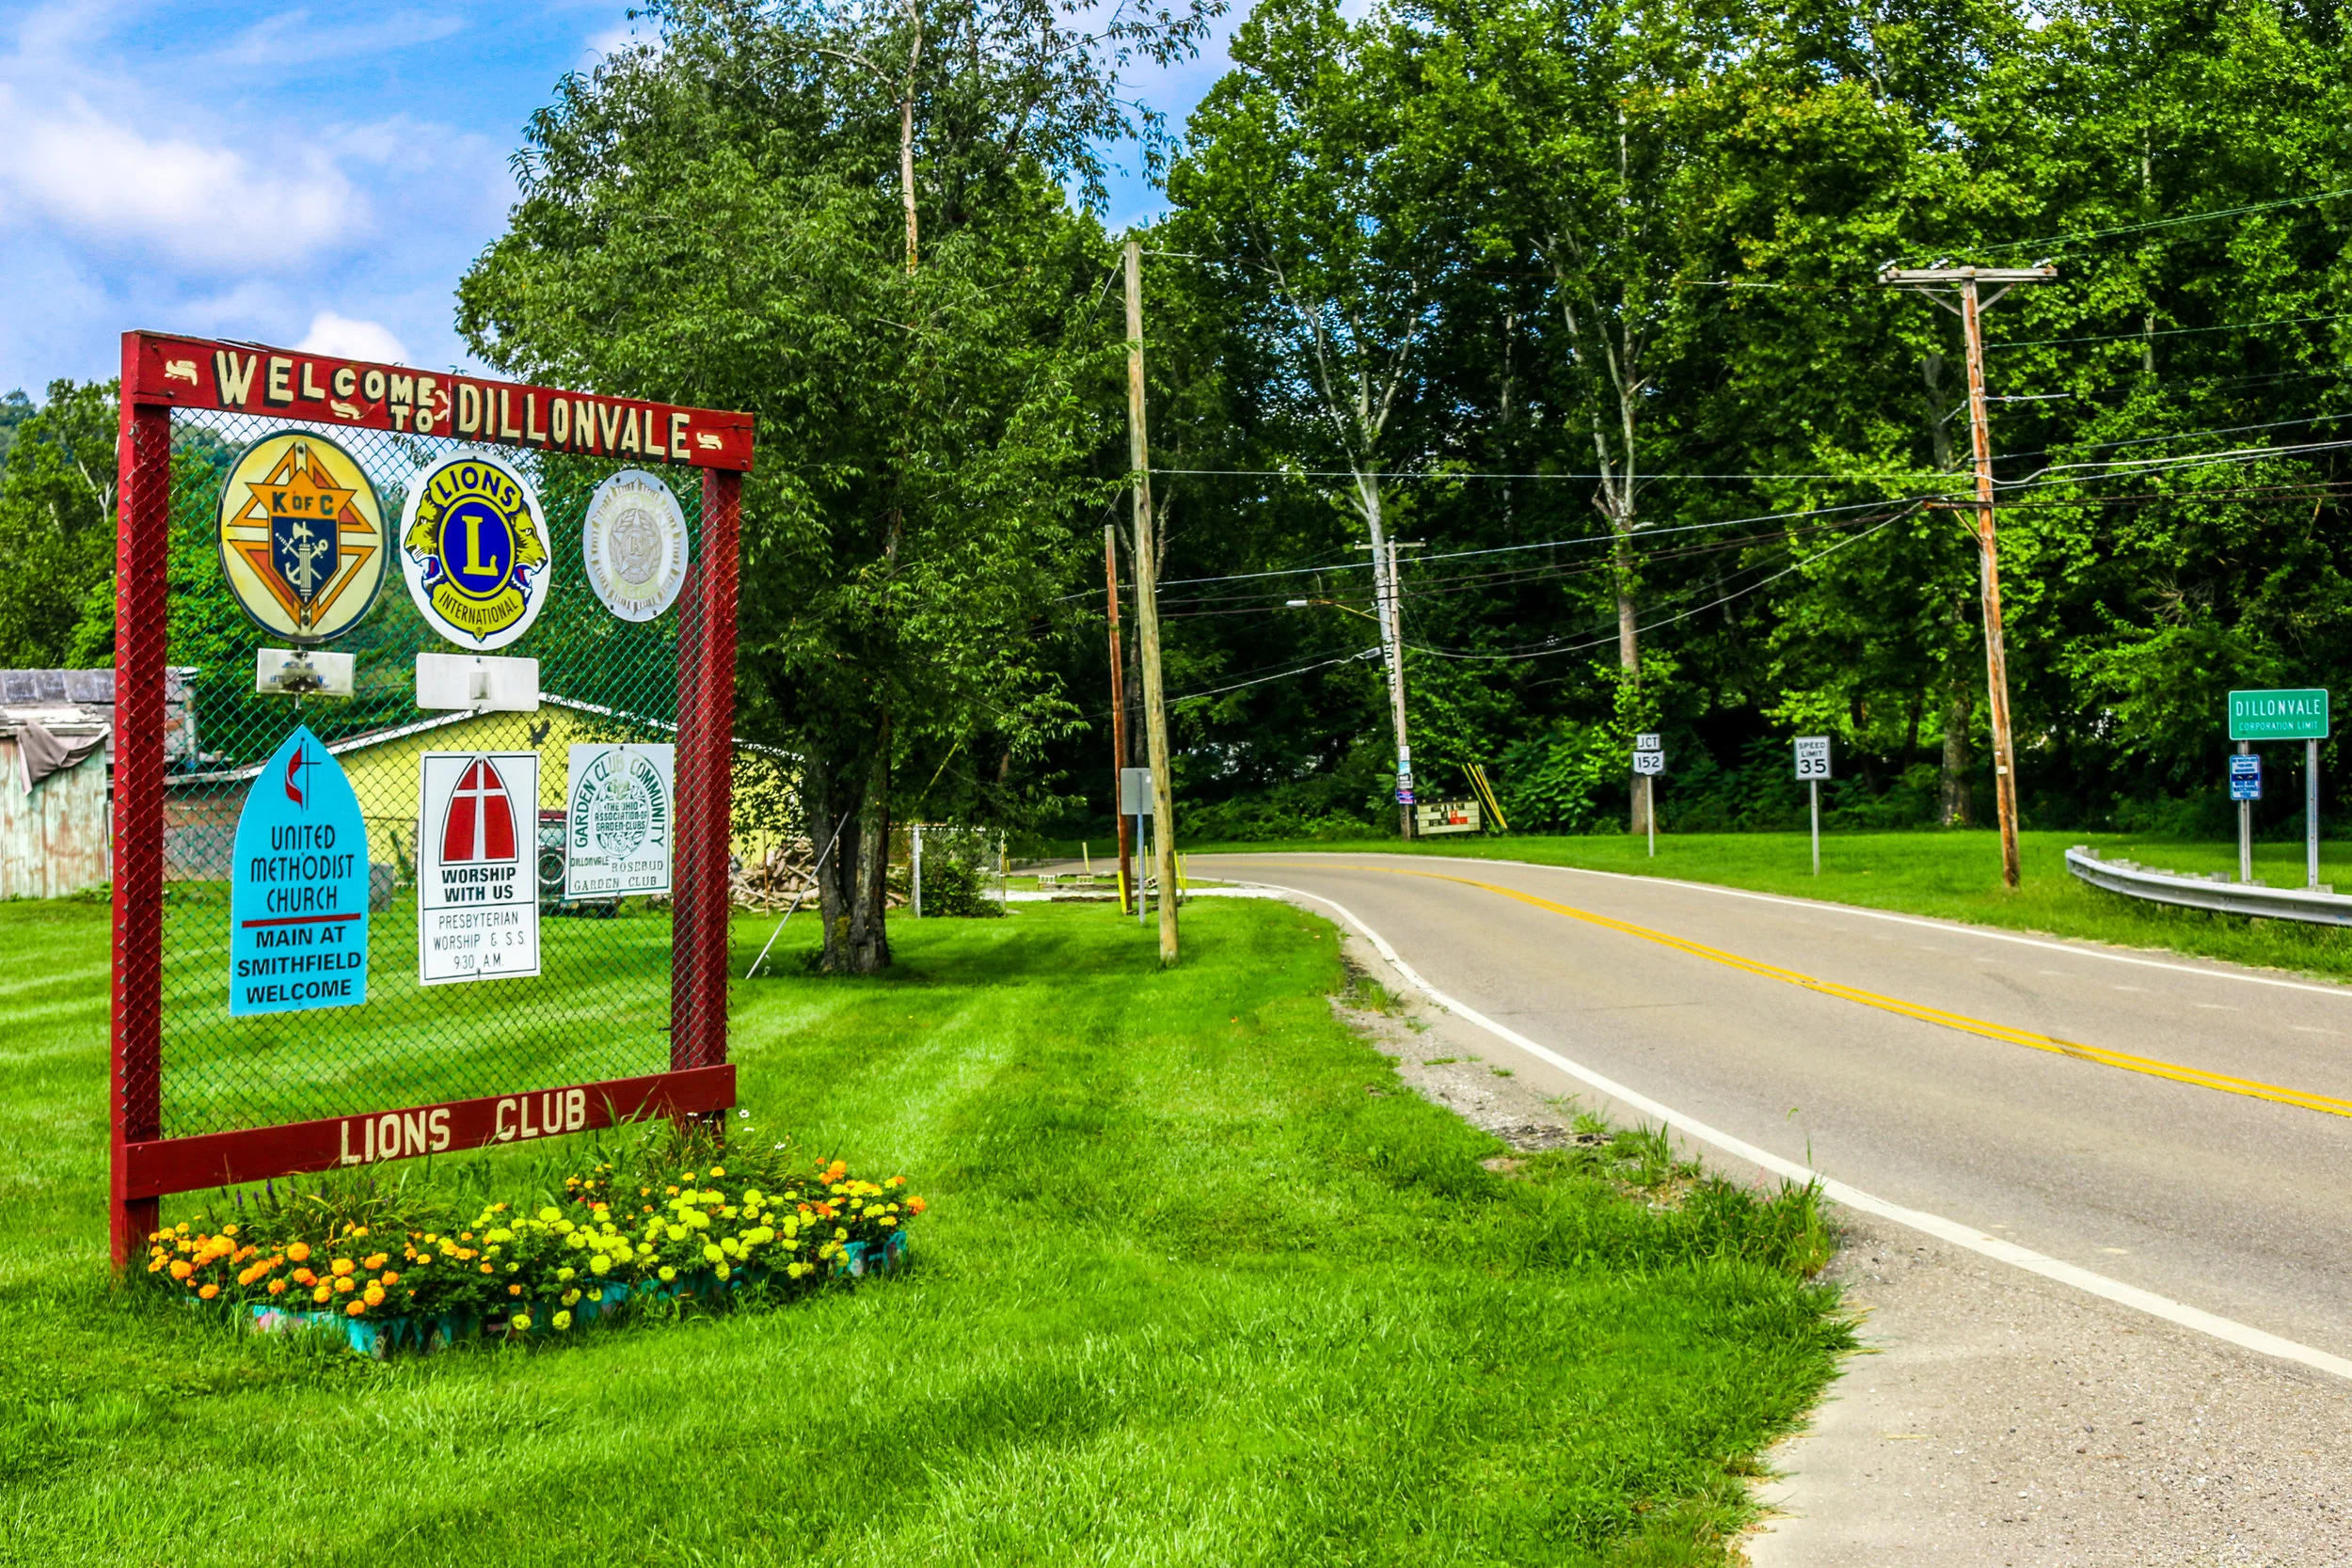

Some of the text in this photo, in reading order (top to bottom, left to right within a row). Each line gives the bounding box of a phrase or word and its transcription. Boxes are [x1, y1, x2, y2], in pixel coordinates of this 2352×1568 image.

[213, 350, 691, 460] WELCOME TO DILLONVALE
[435, 466, 516, 508] LIONS
[271, 491, 287, 514] K
[319, 494, 334, 515] C
[461, 515, 499, 577] L
[438, 590, 519, 626] INTERNATIONAL
[2235, 699, 2321, 717] DILLONVALE
[2238, 721, 2318, 731] CORPORATION LIMIT
[1639, 736, 1658, 748] JCT
[1798, 741, 1825, 750] SPEED
[1637, 756, 1661, 768] 152
[1801, 750, 1823, 758] LIMIT
[595, 754, 625, 782] CLUB
[1800, 758, 1827, 774] 35
[575, 778, 596, 848] GARDEN
[606, 802, 620, 812] THE
[629, 756, 666, 848] COMMUNITY
[271, 824, 336, 851] UNITED
[250, 853, 355, 883] METHODIST
[441, 866, 516, 883] WORSHIP
[612, 860, 664, 873] ROSEBUD
[444, 884, 514, 903] WITH US
[574, 876, 658, 892] GARDEN CLUB
[266, 885, 338, 913] CHURCH
[438, 911, 518, 930] PRESBYTERIAN
[255, 926, 347, 949] MAIN AT
[433, 933, 481, 952] WORSHIP
[490, 932, 498, 947] &
[237, 951, 362, 977] SMITHFIELD
[246, 978, 353, 1005] WELCOME
[341, 1088, 586, 1165] LIONS CLUB
